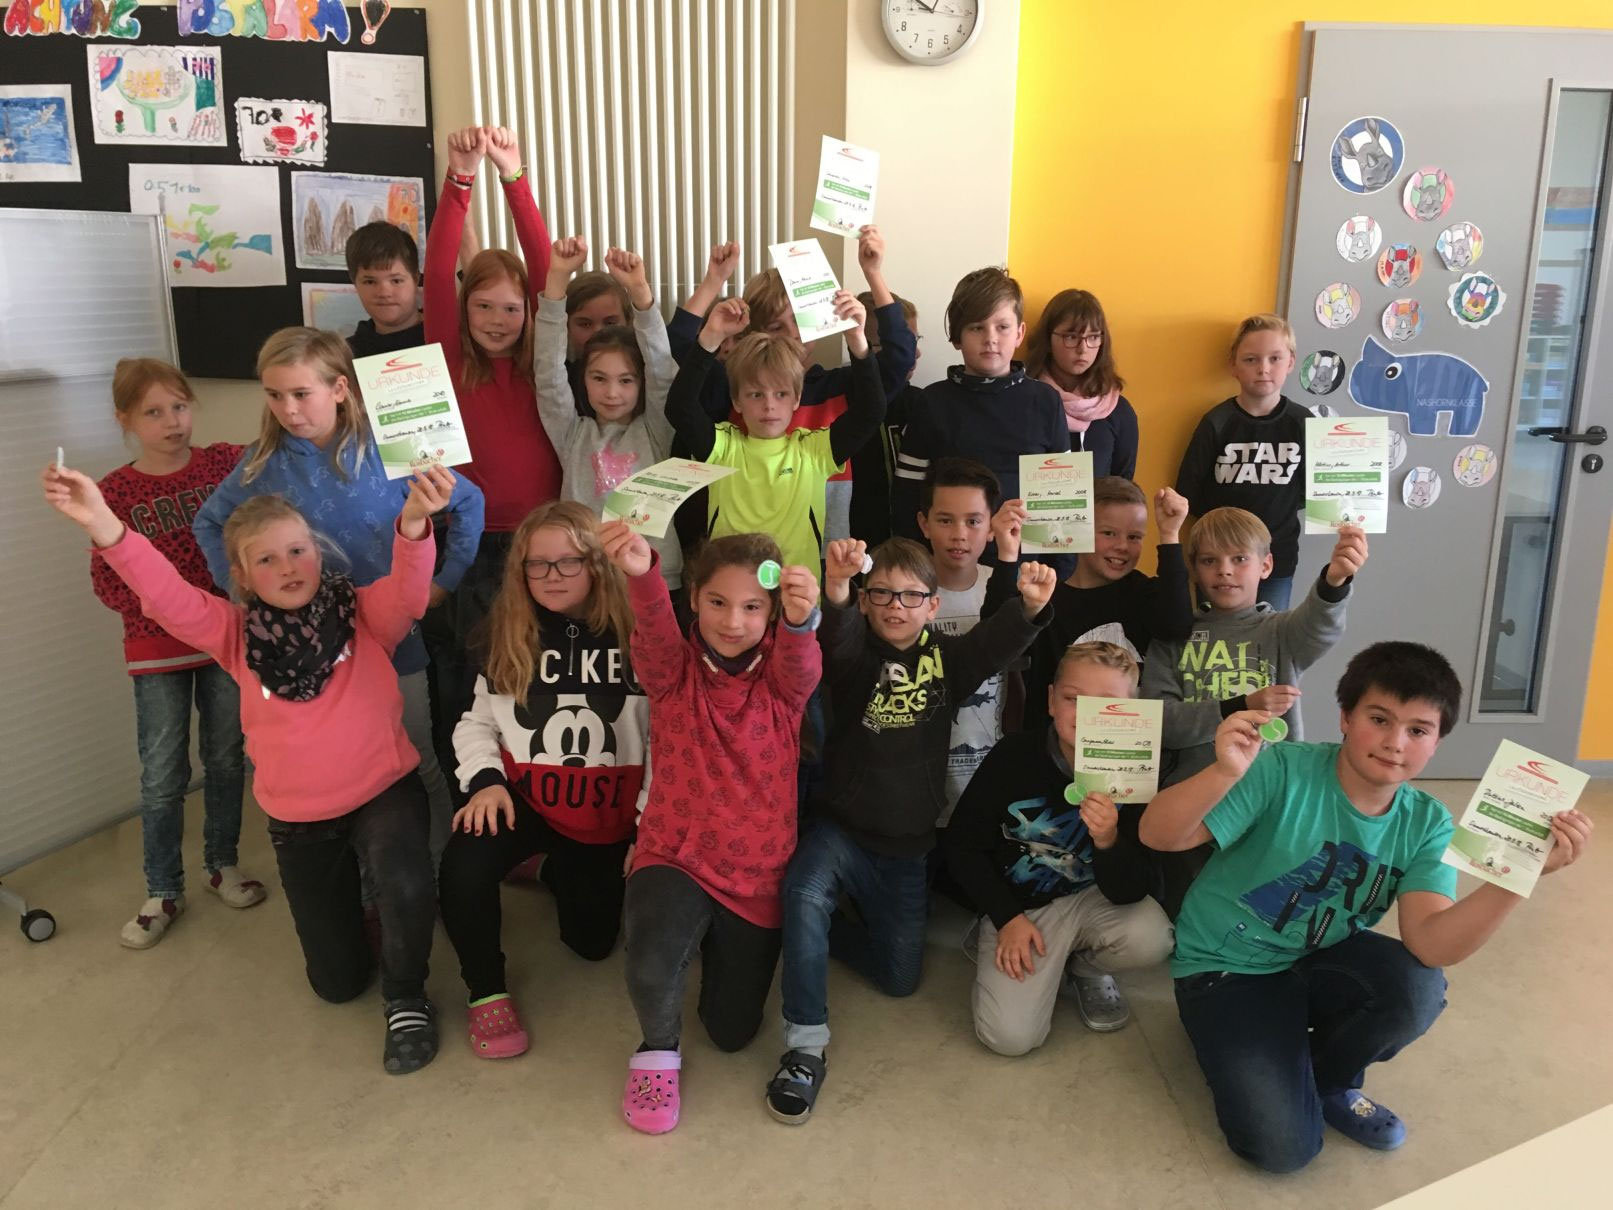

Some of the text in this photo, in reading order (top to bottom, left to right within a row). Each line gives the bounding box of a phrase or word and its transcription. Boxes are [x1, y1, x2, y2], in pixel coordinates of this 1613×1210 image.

[901, 21, 907, 32] 8
[956, 24, 962, 34] 4
[914, 33, 919, 43] 7
[927, 38, 933, 49] 6
[943, 34, 949, 45] 5
[1216, 442, 1302, 464] STAR
[1214, 463, 1299, 485] WARS
[539, 648, 640, 684] CKE
[880, 713, 916, 724] CONTROL
